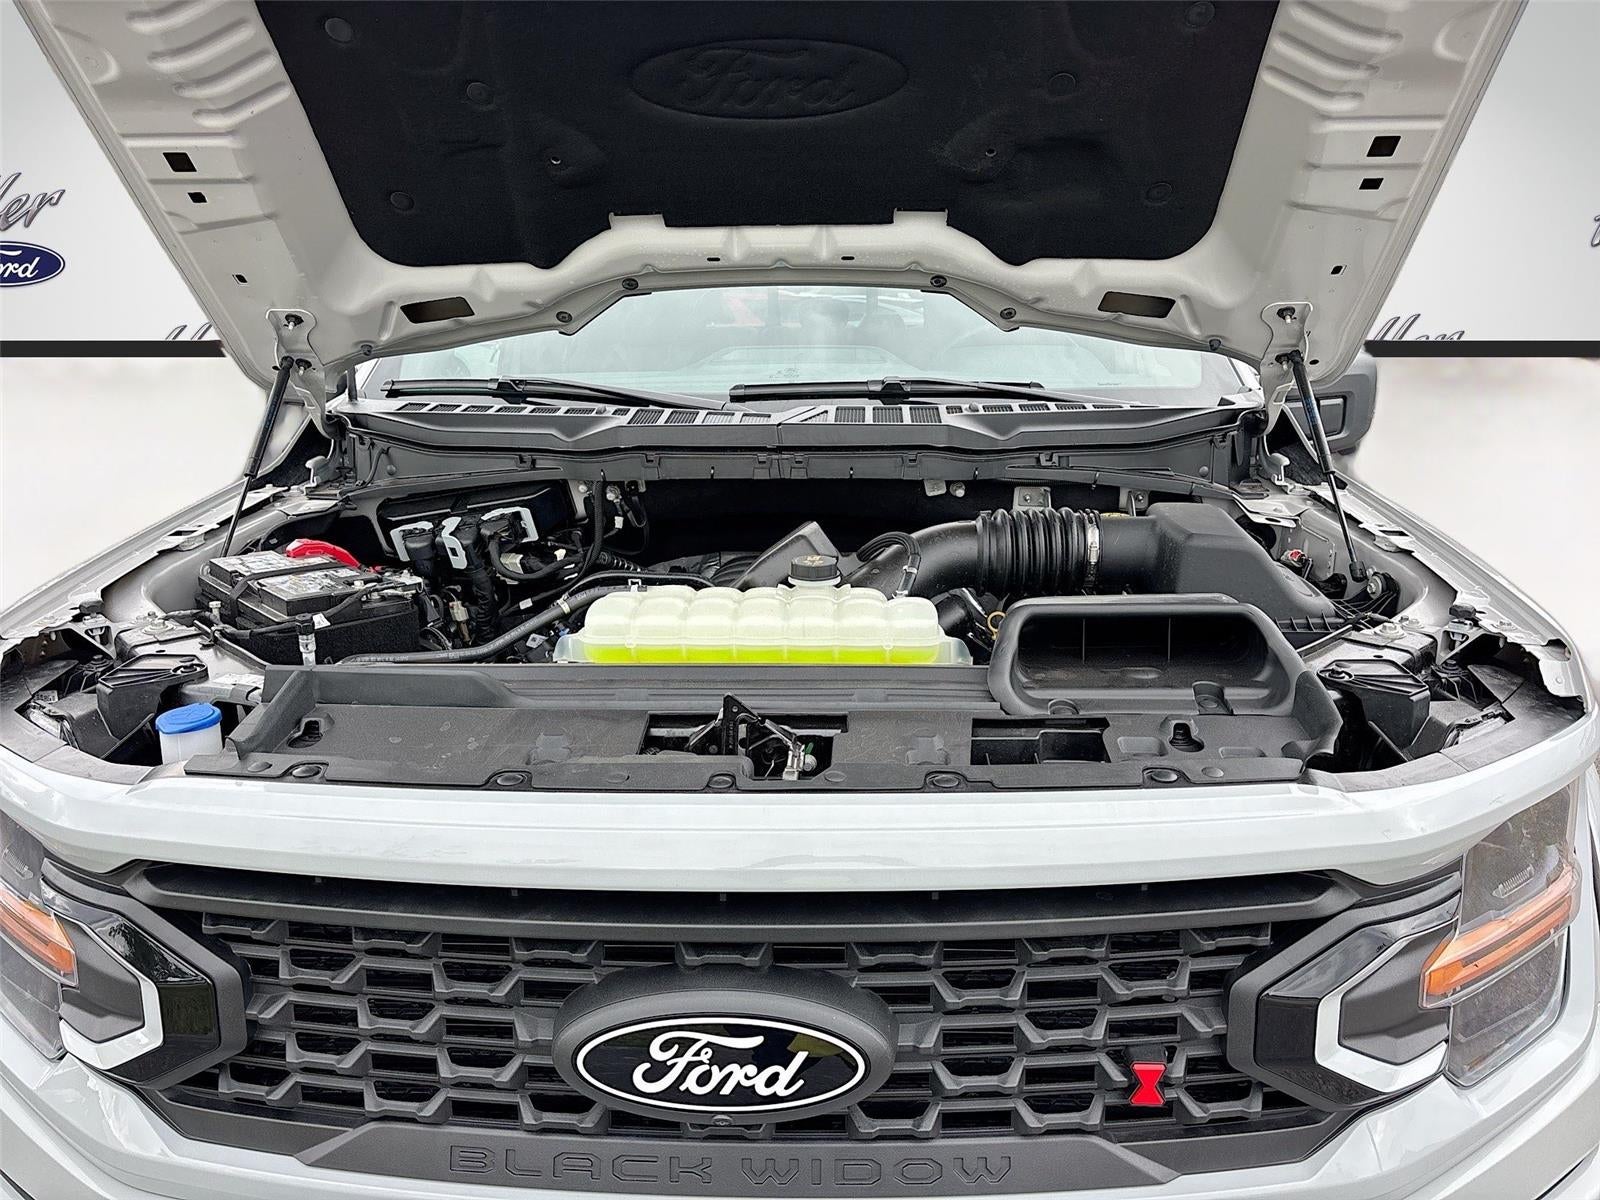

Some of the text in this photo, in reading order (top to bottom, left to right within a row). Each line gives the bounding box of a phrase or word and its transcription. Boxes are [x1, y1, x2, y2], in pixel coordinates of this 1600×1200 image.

[676, 48, 860, 107] Ford
[632, 1030, 809, 1097] Ford
[450, 1145, 1012, 1186] BLACK WIDOW
